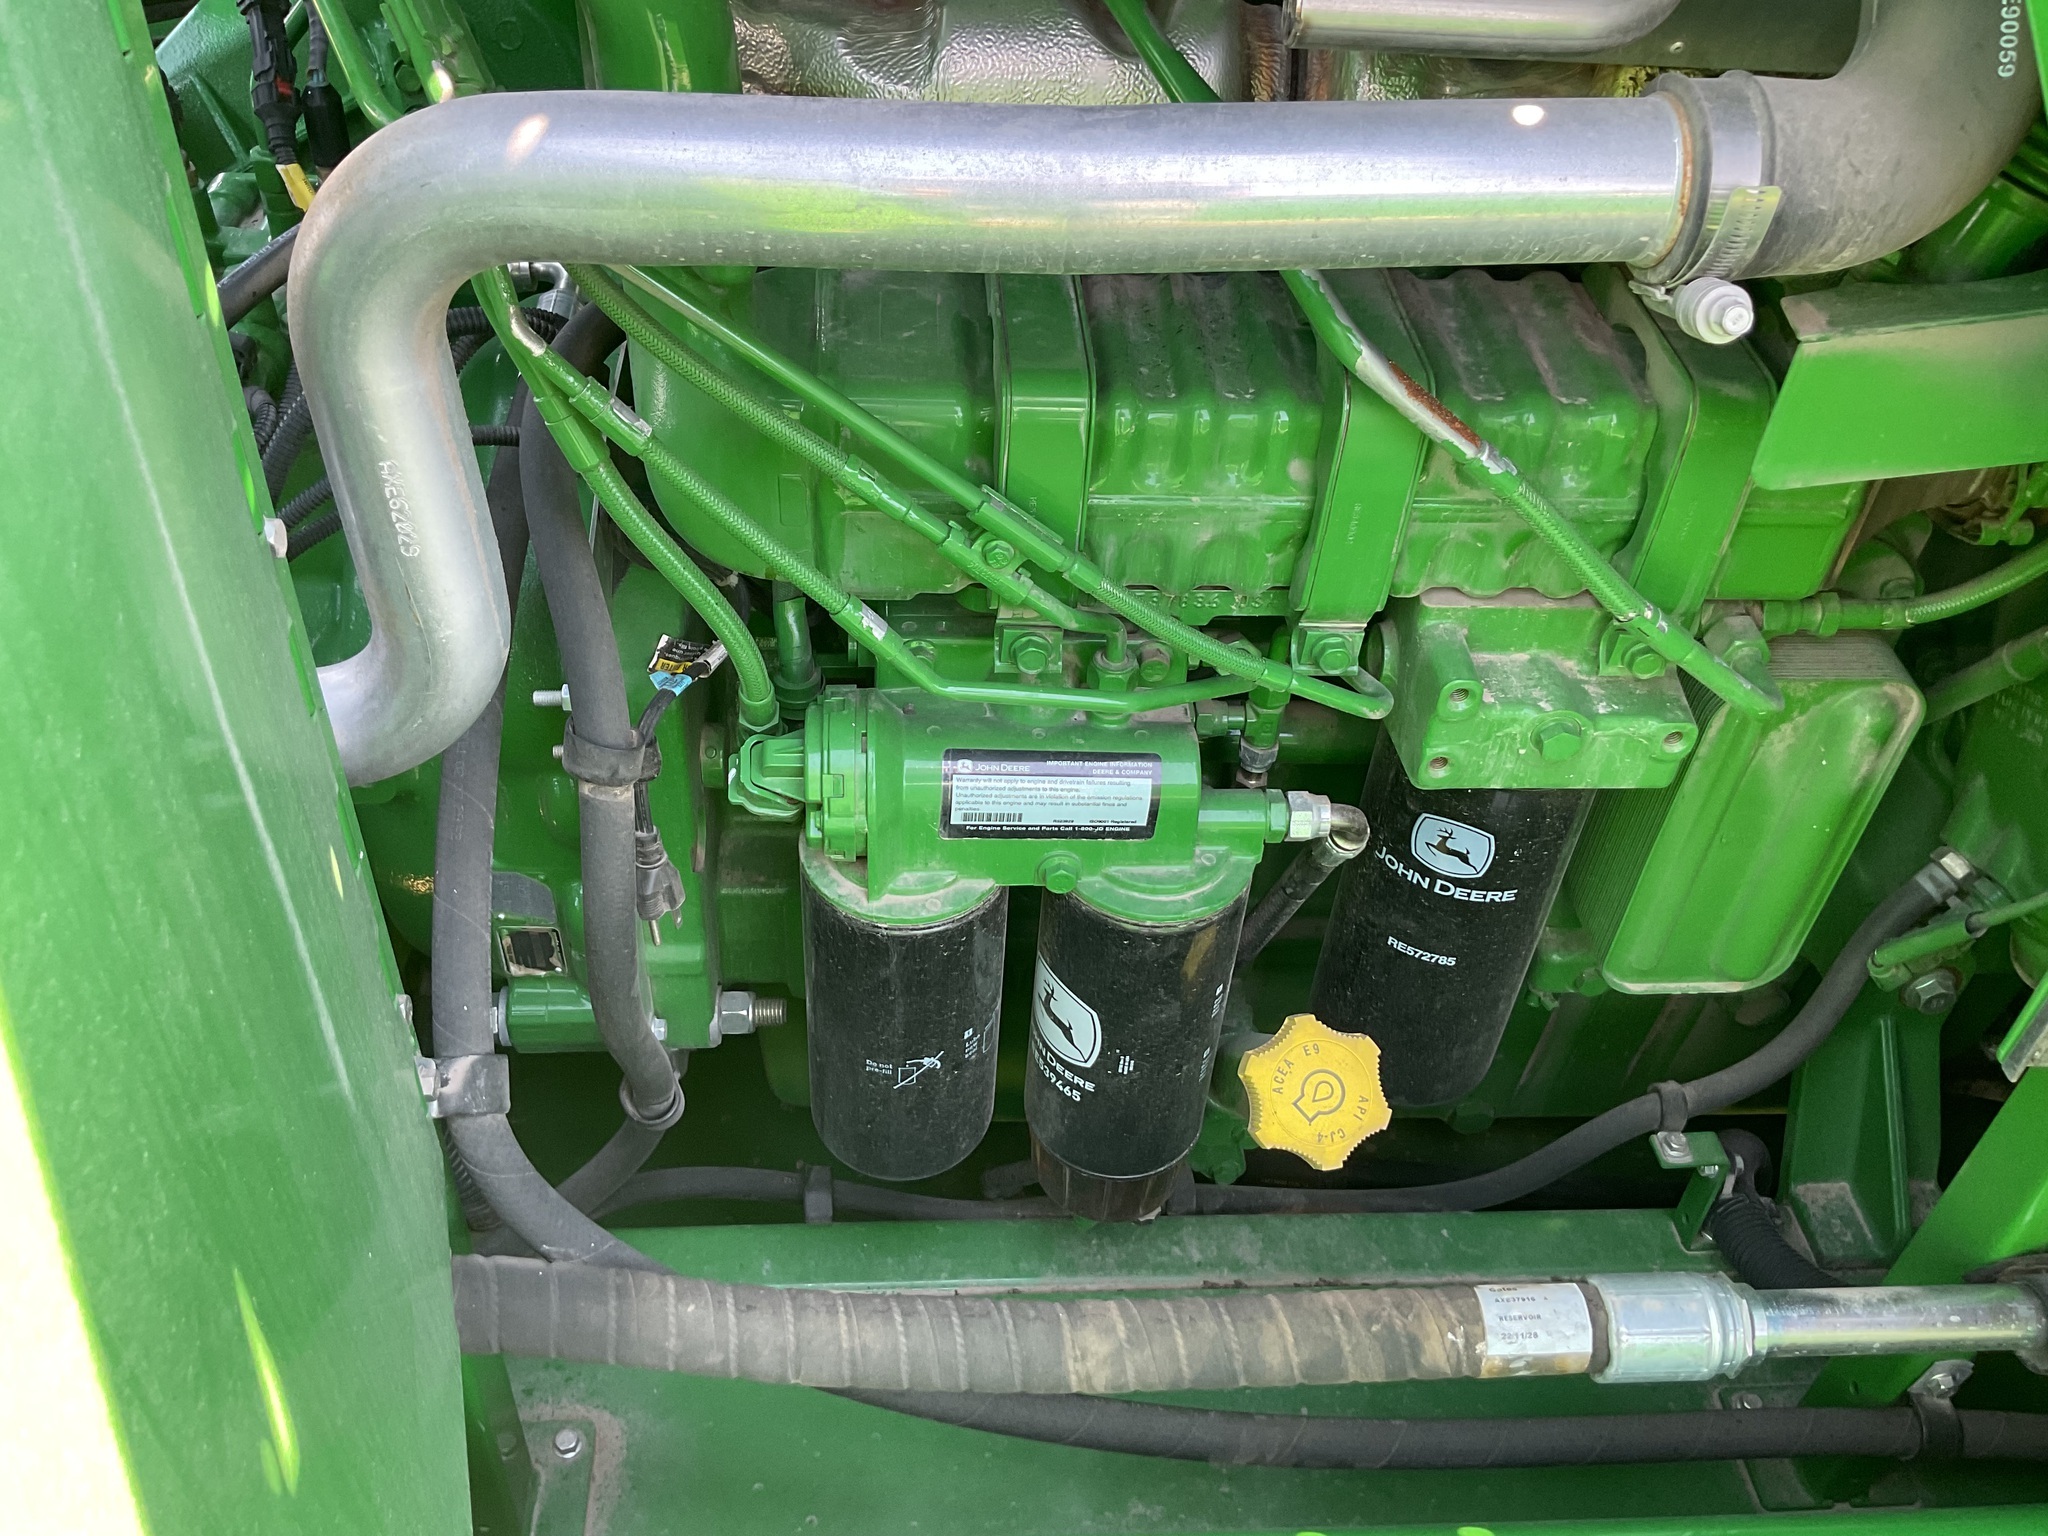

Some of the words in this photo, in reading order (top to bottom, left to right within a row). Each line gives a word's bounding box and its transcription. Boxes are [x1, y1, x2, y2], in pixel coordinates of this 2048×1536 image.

[1998, 0, 2021, 78] 90059
[975, 764, 1000, 772] JOHN
[1000, 763, 1031, 772] DEERE
[1375, 846, 1431, 890] JOHN
[1433, 878, 1519, 903] DEERE
[1386, 935, 1457, 967] RE572785
[865, 1059, 878, 1067] Do
[879, 1062, 893, 1070] not
[865, 1066, 892, 1075] pre-fill
[1046, 1051, 1096, 1092] DEERE
[1272, 1058, 1295, 1095] ACEA
[1302, 1043, 1321, 1057] E9
[1353, 1095, 1369, 1121] API
[1317, 1127, 1347, 1143] CJ-4
[1498, 1314, 1542, 1322] RESERVOIR
